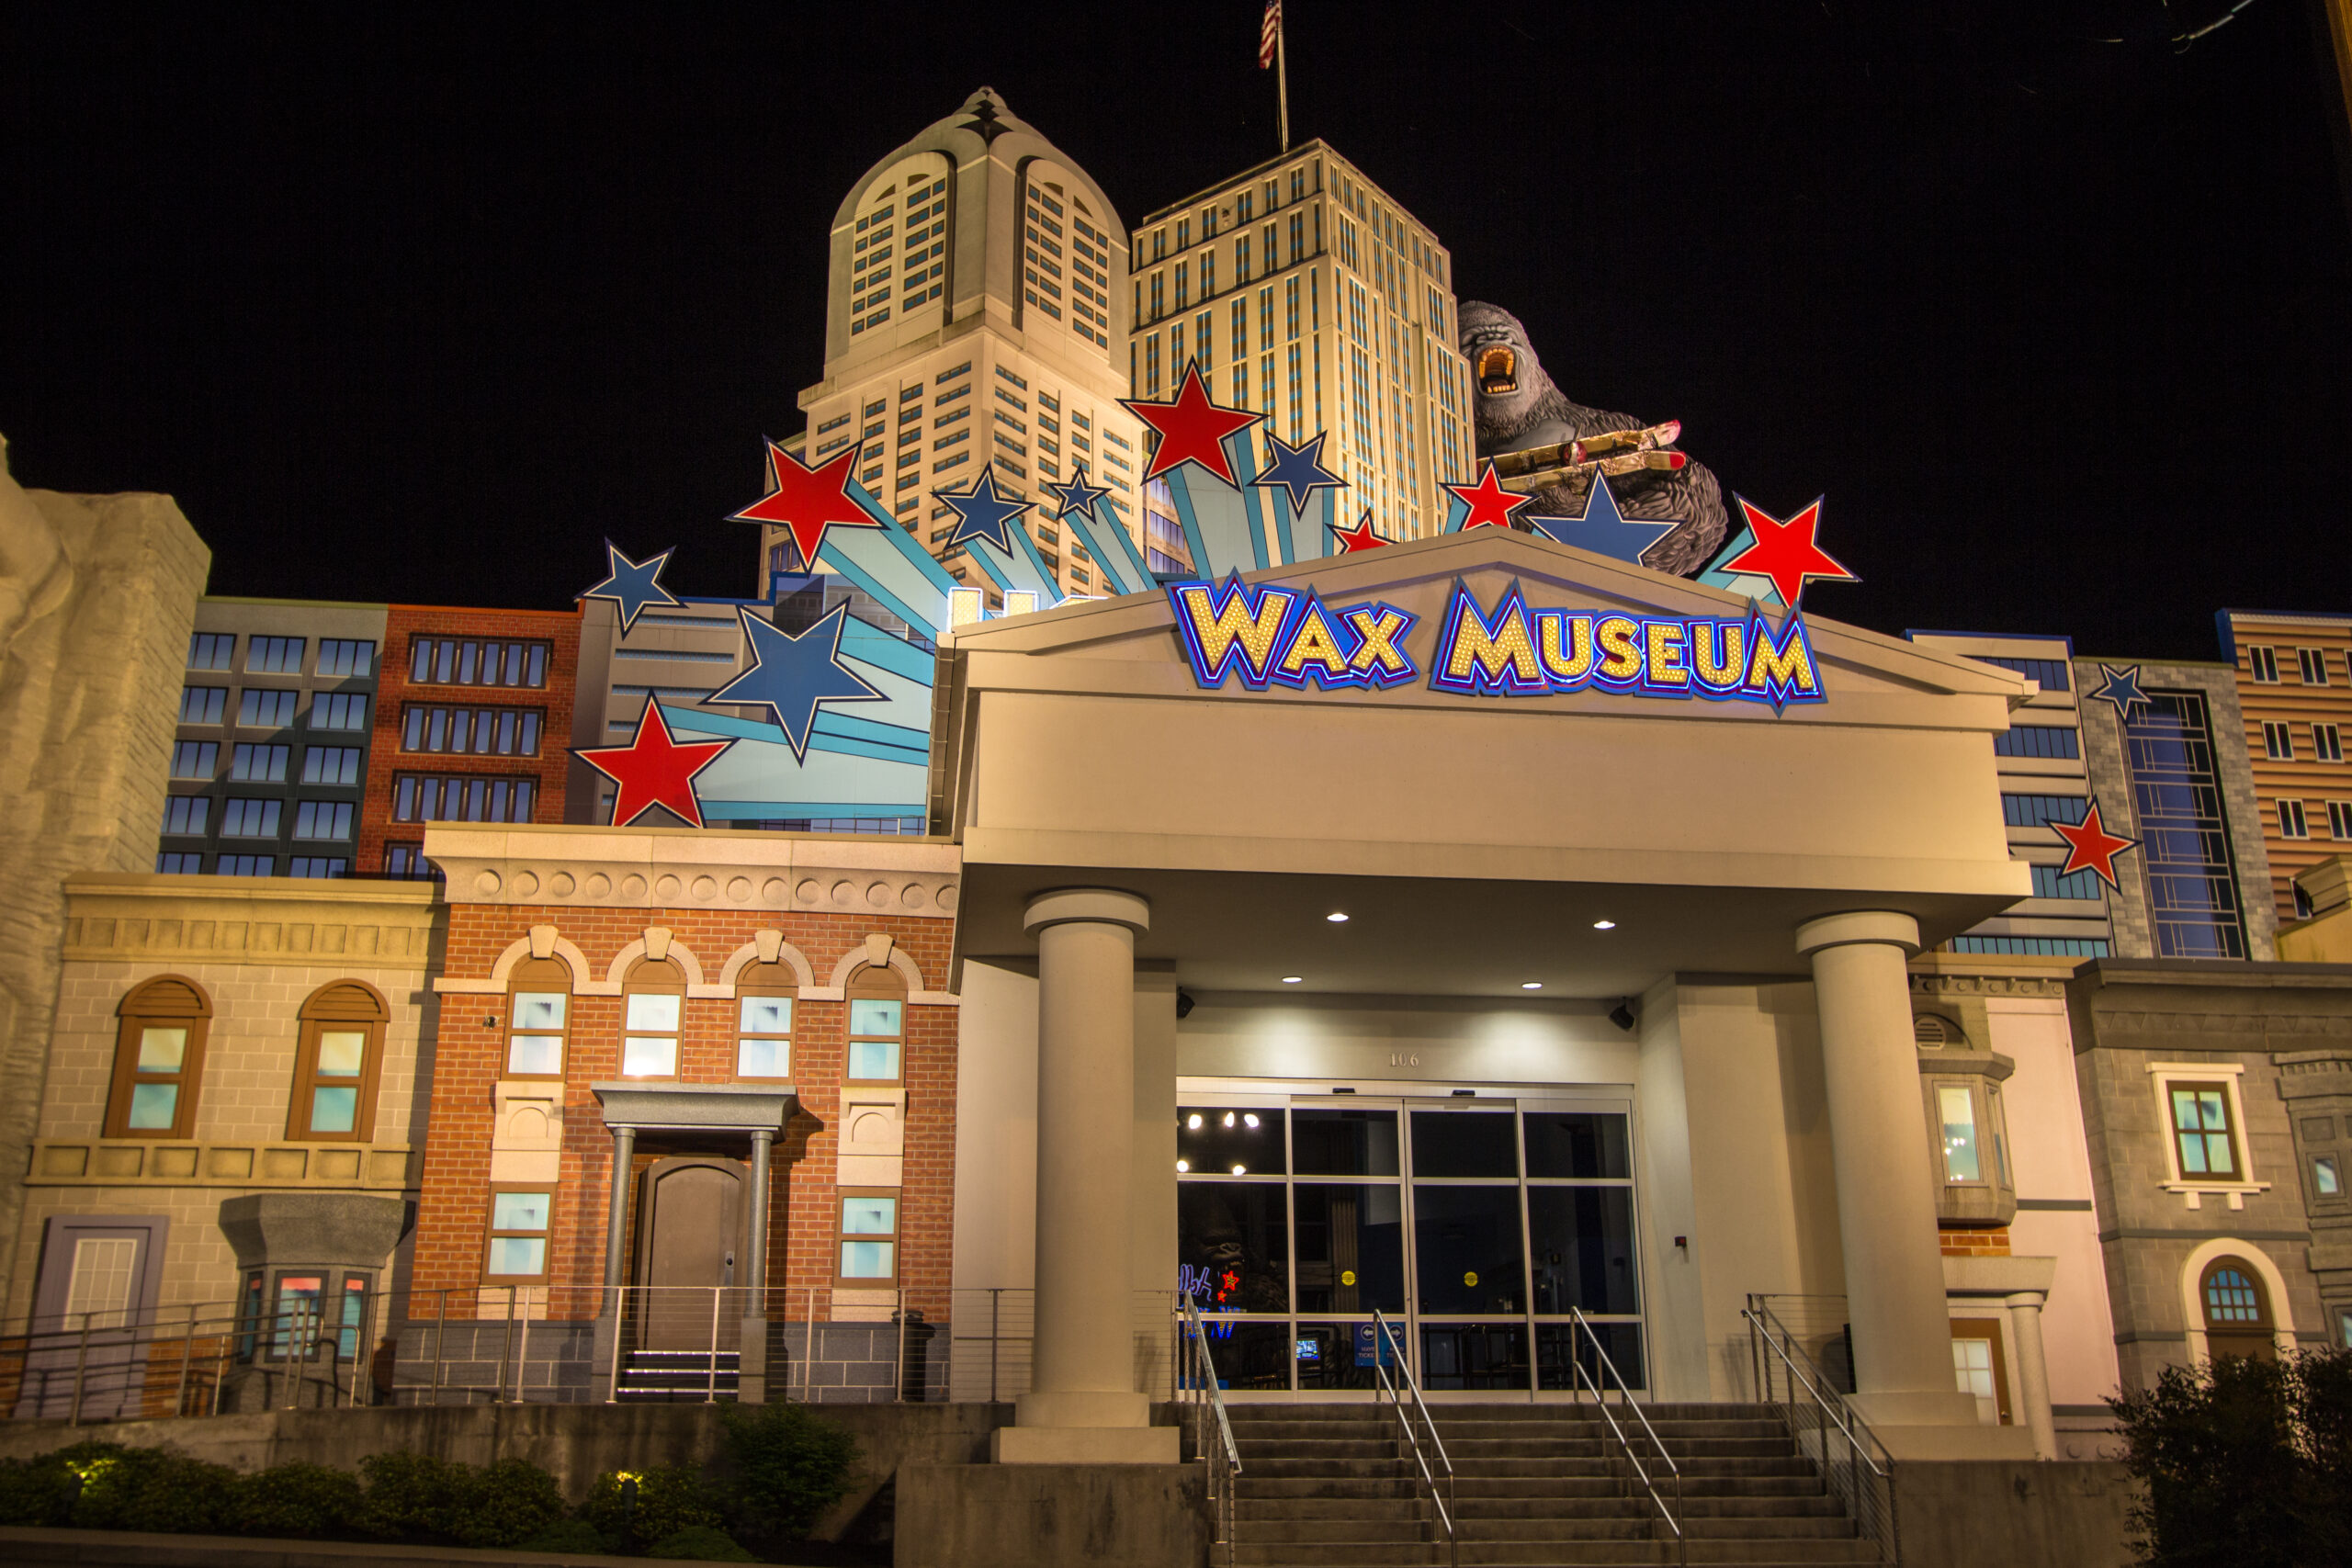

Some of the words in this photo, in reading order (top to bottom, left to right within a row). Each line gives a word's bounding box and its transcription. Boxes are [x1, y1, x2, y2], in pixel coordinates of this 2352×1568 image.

[1176, 582, 1411, 681] WAX
[1441, 593, 1818, 698] MUSEUM
[1389, 1052, 1419, 1066] 106
